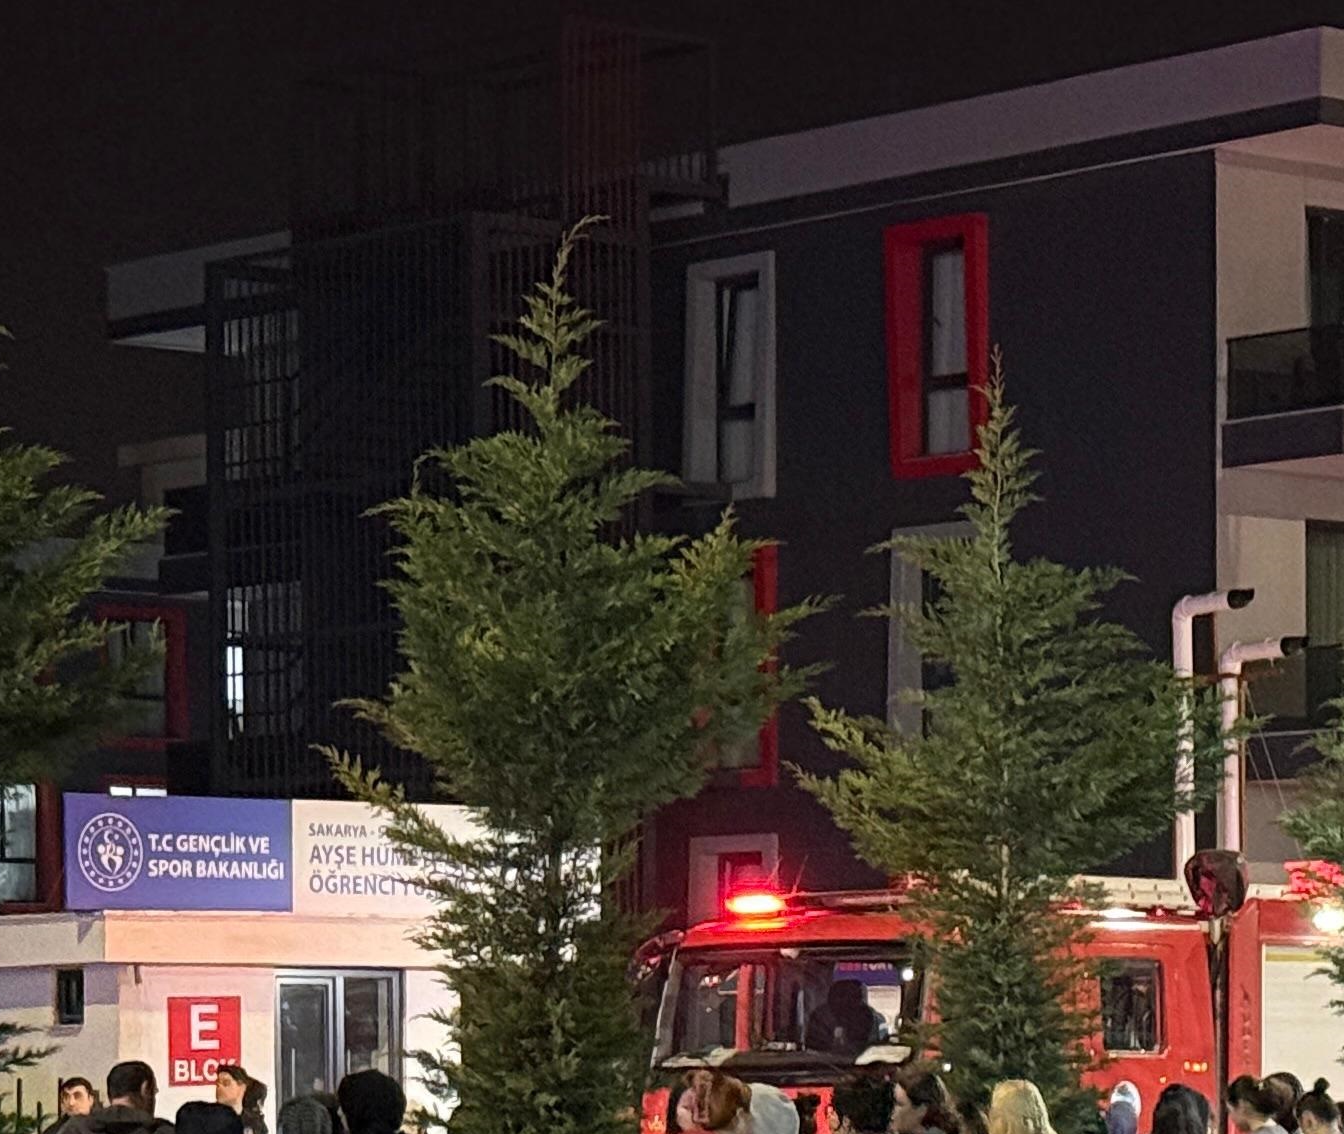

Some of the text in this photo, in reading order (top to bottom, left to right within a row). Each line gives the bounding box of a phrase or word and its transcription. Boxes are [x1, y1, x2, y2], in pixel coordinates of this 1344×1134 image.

[308, 822, 367, 838] SAKARYA
[147, 832, 271, 858] T.C GENÇLİK VE
[309, 844, 356, 870] AYŞE
[148, 858, 285, 880] SPOR BAKANLIĞI
[309, 869, 396, 896] ÖĞRENCİ
[190, 1004, 220, 1051] E
[174, 1058, 236, 1082] BLO
